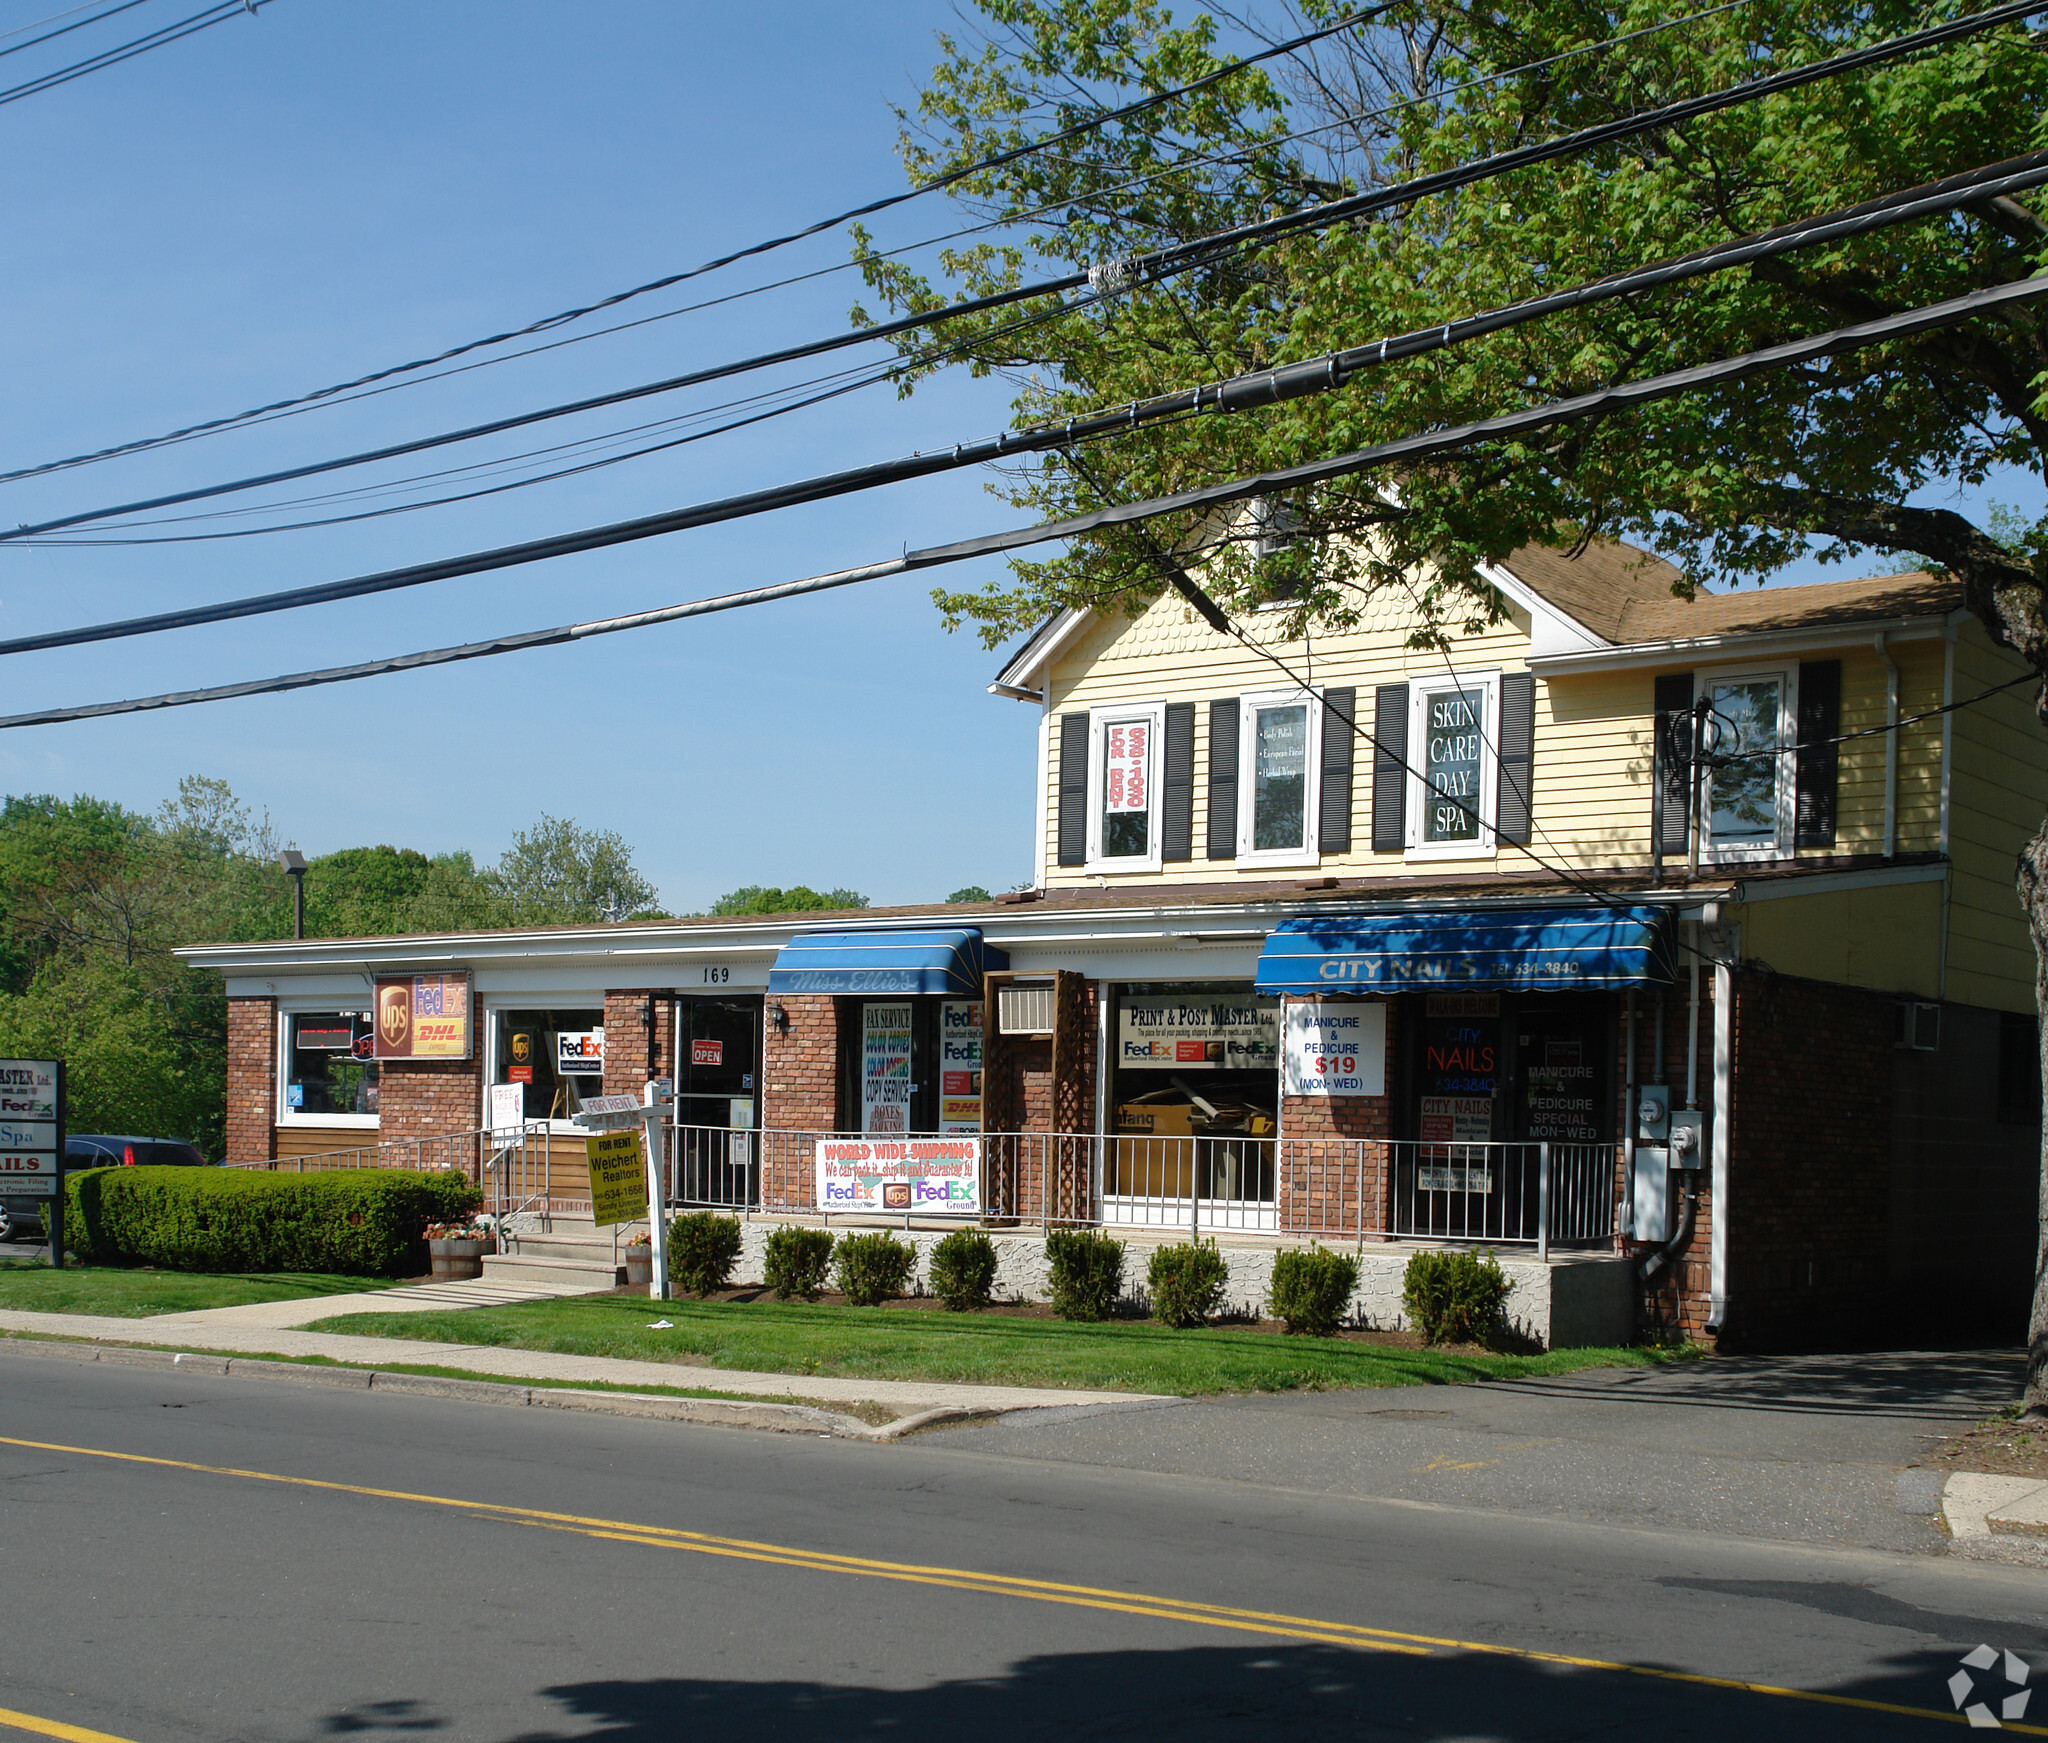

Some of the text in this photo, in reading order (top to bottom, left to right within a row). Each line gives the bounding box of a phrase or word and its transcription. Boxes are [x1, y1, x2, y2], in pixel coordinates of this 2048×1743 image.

[1433, 699, 1475, 728] SKIN
[1110, 728, 1126, 759] FOR
[1430, 734, 1478, 763] CARE
[1109, 768, 1124, 808] RENT
[1434, 770, 1471, 798] DAY
[1436, 806, 1467, 832] SPA
[703, 967, 729, 983] 169
[1319, 960, 1383, 979] CITY
[1389, 957, 1477, 978] NAILS
[789, 970, 919, 991] Miss Ellie's
[414, 975, 464, 1015] FedEx
[383, 1005, 406, 1037] ups
[866, 1008, 911, 1028] FAX SERVICE
[1130, 1004, 1275, 1026] PRINT & POST MASTER Ltd.
[1304, 1017, 1360, 1028] MANICURE
[419, 1025, 457, 1040] DHL
[1330, 1030, 1338, 1040] &
[1446, 1026, 1481, 1043] CITY
[514, 1042, 528, 1057] ups
[560, 1036, 601, 1057] FedEx
[866, 1030, 911, 1054] COLOR COPIES
[1124, 1041, 1172, 1056] FedEx
[1228, 1041, 1275, 1054] FedEx
[1304, 1043, 1359, 1054] PEDICURE
[694, 1049, 720, 1062] OPEN
[1427, 1046, 1495, 1072] NAILS
[867, 1057, 909, 1077] COLOR POSTERS
[1315, 1056, 1356, 1075] $19
[1528, 1066, 1594, 1078] MANICURE
[495, 1089, 513, 1101] FREE
[865, 1079, 909, 1103] COPY SERVICE
[1556, 1081, 1565, 1092] &
[2, 1098, 52, 1111] FedEx
[587, 1096, 633, 1113] FOR RENT
[874, 1105, 900, 1120] BOXES
[1423, 1098, 1490, 1115] CITY NAILS
[1529, 1098, 1593, 1110] PEDICURE
[1533, 1112, 1589, 1125] SPECIAL
[1, 1125, 33, 1146] Spa
[598, 1137, 631, 1151] FOR RENT
[824, 1142, 974, 1160] WORLD WIDE SHIPPING
[1458, 1148, 1484, 1156] Spcial
[0, 1157, 40, 1170] ILS
[591, 1152, 638, 1172] Weichert
[602, 1168, 640, 1183] Realtors
[825, 1161, 837, 1177] We
[839, 1164, 851, 1177] can
[853, 1162, 870, 1181] pack
[908, 1161, 922, 1177] and
[924, 1161, 963, 1177] Guarantee
[28, 1178, 49, 1186] Filing
[826, 1182, 875, 1199] FedEx
[916, 1180, 973, 1200] FedEx
[888, 1192, 907, 1204] ups
[946, 1201, 975, 1209] Ground
